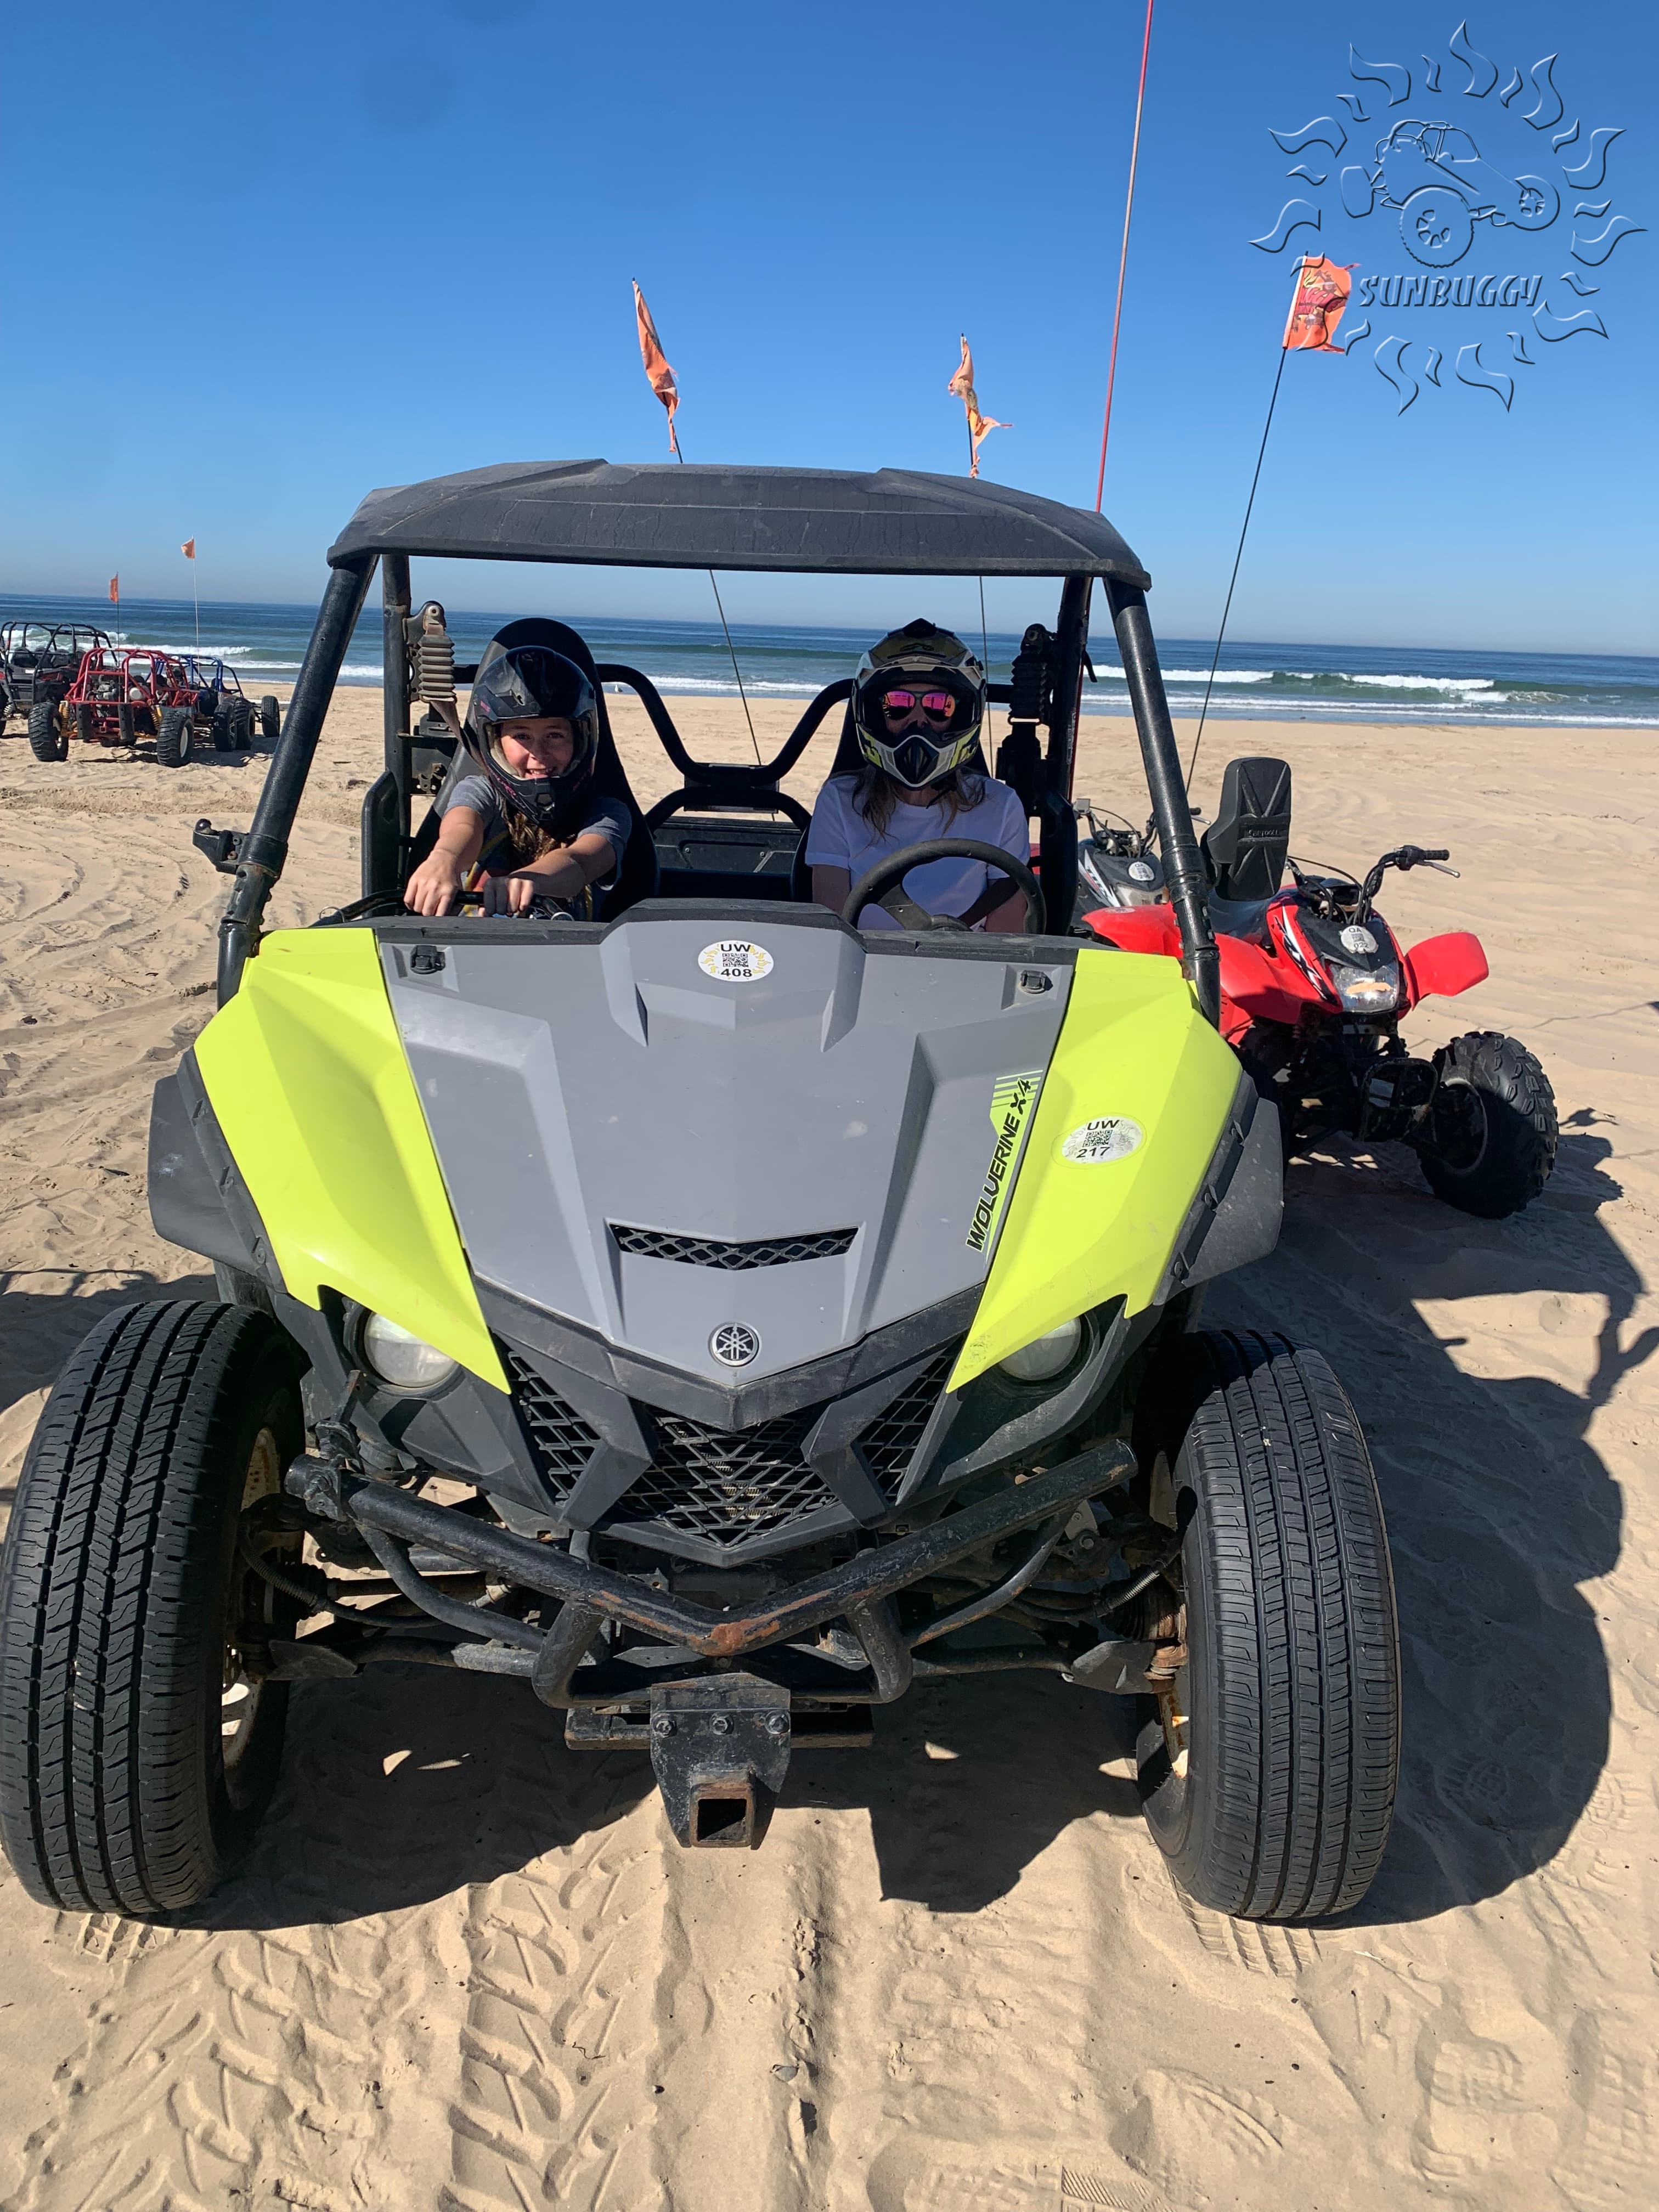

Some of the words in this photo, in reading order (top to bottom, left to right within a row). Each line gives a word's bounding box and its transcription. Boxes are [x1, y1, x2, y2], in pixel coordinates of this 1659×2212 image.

[720, 944, 751, 952] UW
[720, 968, 752, 977] 408
[1087, 1119, 1120, 1130] UW
[1076, 1147, 1111, 1159] 217
[966, 1112, 1020, 1250] WOLVERINE
[1009, 1077, 1031, 1115] X4
